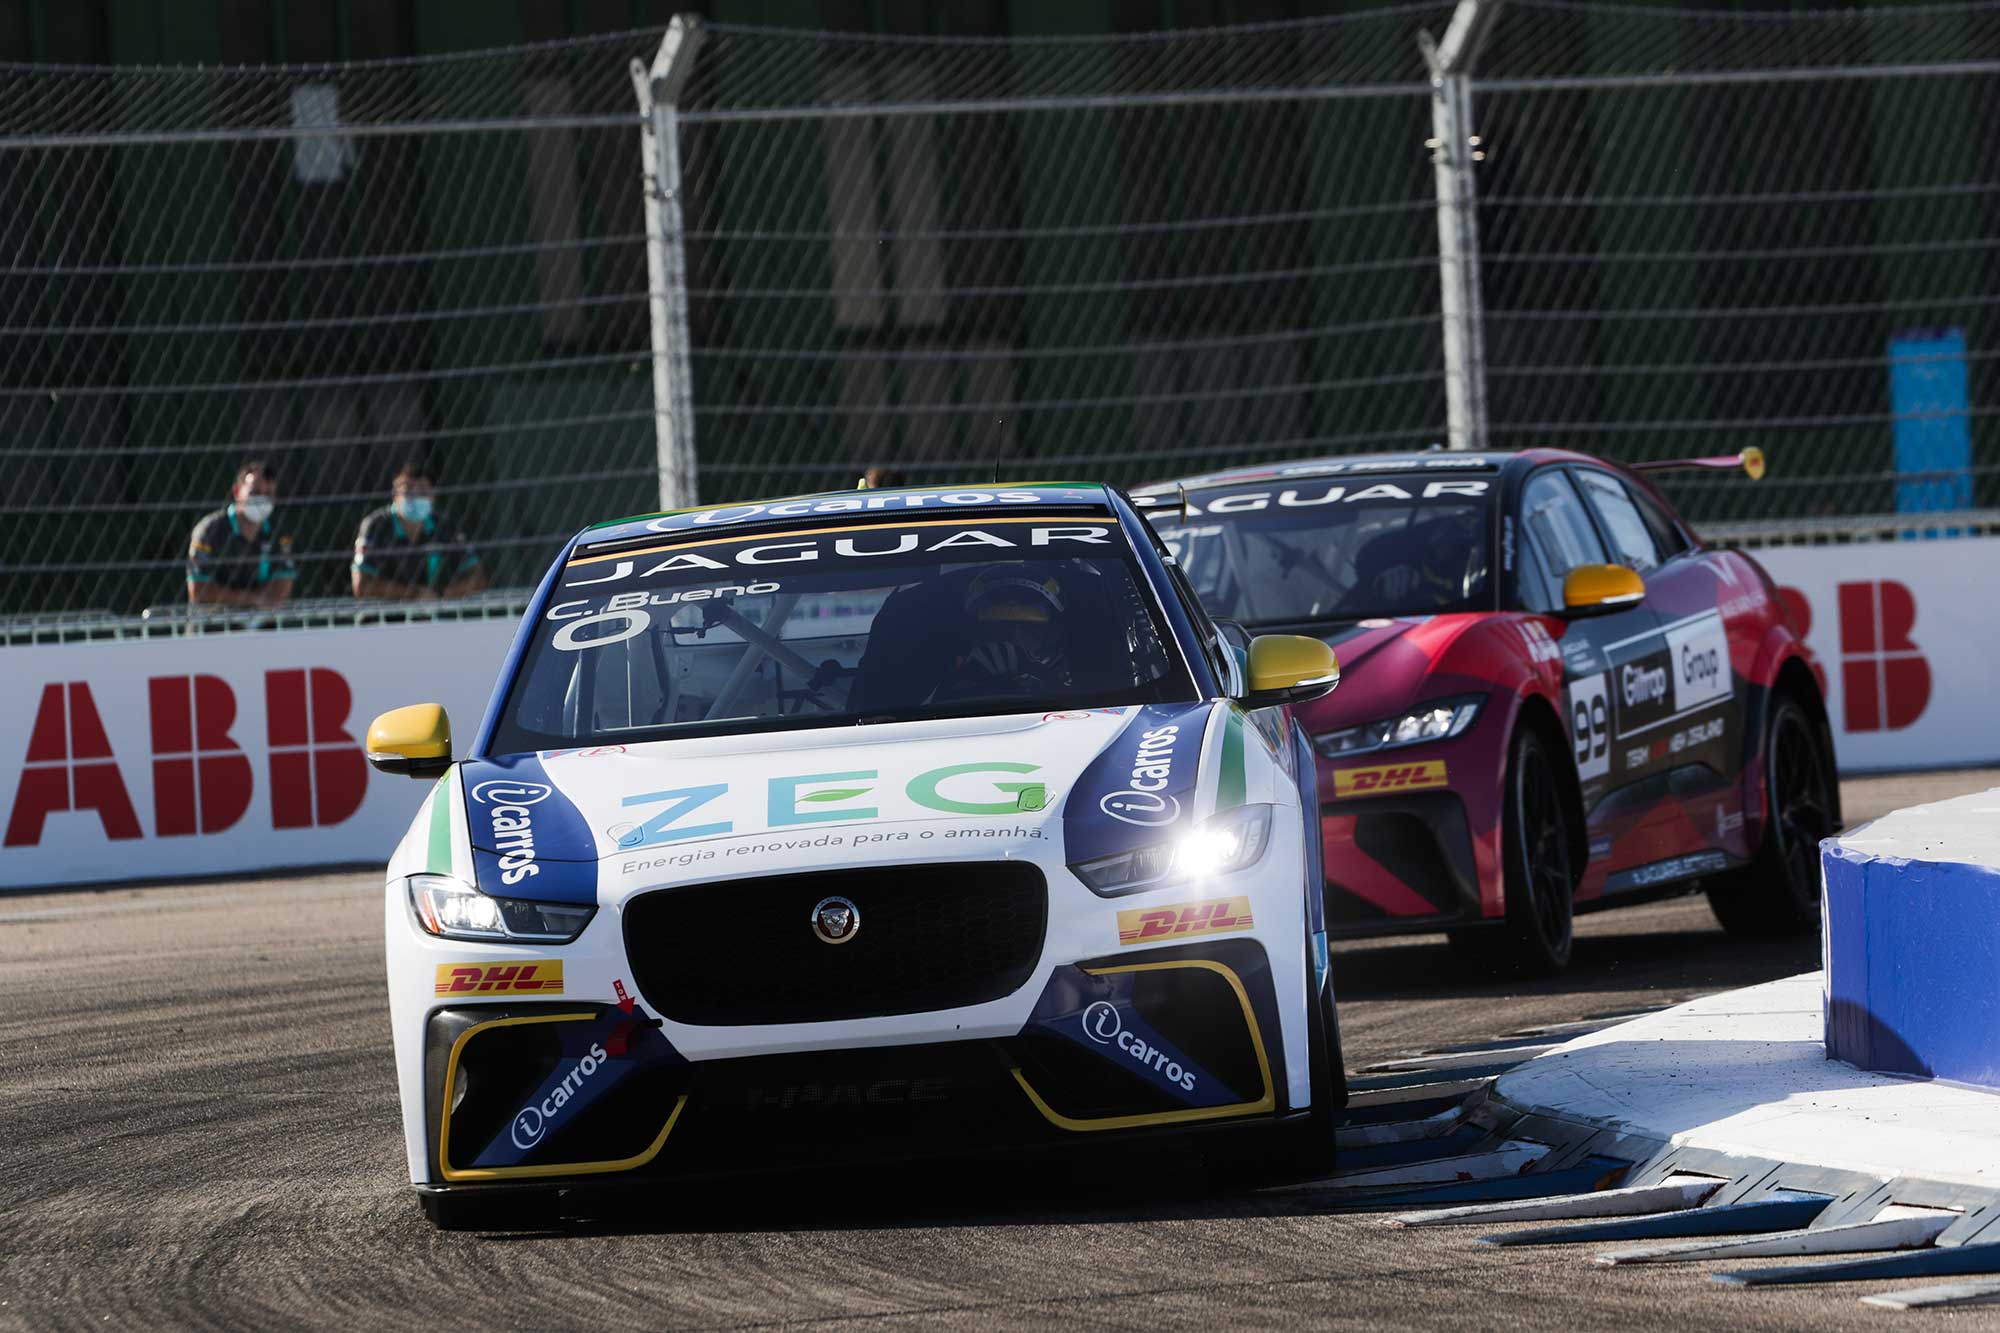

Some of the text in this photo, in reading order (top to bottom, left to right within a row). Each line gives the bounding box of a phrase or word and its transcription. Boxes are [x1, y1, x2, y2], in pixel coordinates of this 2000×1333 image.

[1144, 481, 1489, 521] AGUAR
[565, 526, 1110, 587] JAGUAR
[546, 582, 781, 621] C. Bueno
[1682, 644, 1720, 689] Group
[3, 667, 369, 847] ABB
[1575, 694, 1608, 764] 99
[617, 761, 1046, 851] ZEG
[1099, 725, 1181, 826] icarros
[1352, 766, 1433, 790] DHL
[471, 780, 552, 885] icarros
[621, 826, 1049, 875] Energia renovada para o amanhã.
[1136, 903, 1236, 938] DHL
[451, 965, 545, 992] DHL
[1082, 1001, 1198, 1092] icarros
[511, 1041, 608, 1149] icarros
